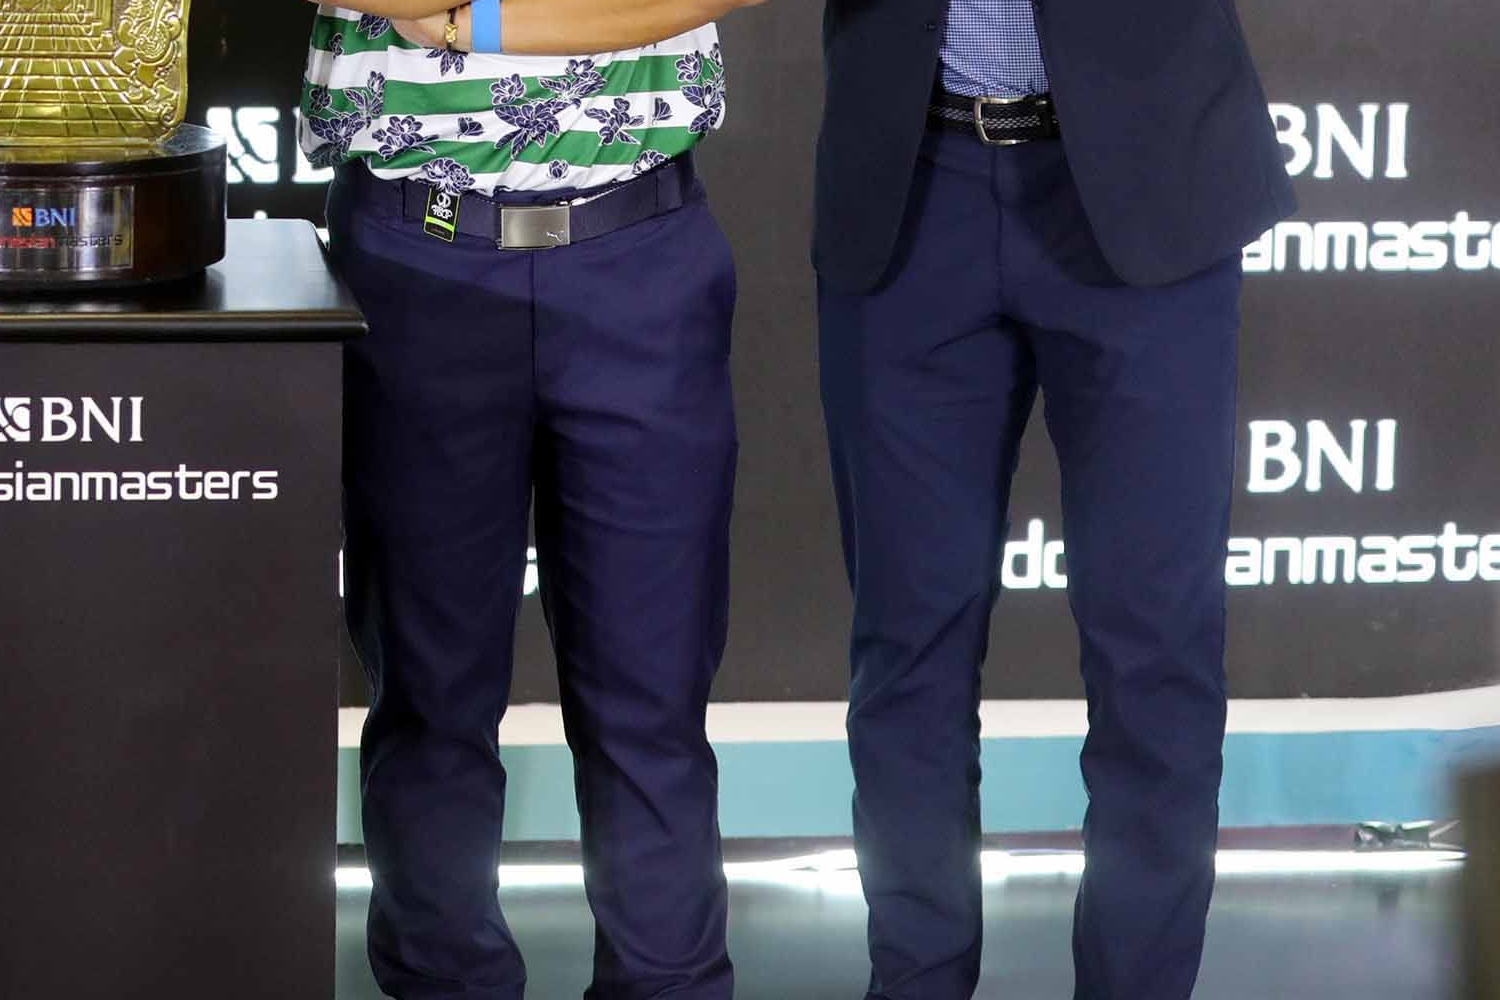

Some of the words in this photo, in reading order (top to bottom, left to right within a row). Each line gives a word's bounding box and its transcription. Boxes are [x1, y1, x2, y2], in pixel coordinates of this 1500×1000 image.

[1267, 102, 1409, 179] BNI
[34, 207, 77, 228] BNI
[41, 396, 143, 443] BNI
[1247, 418, 1397, 493] BNI
